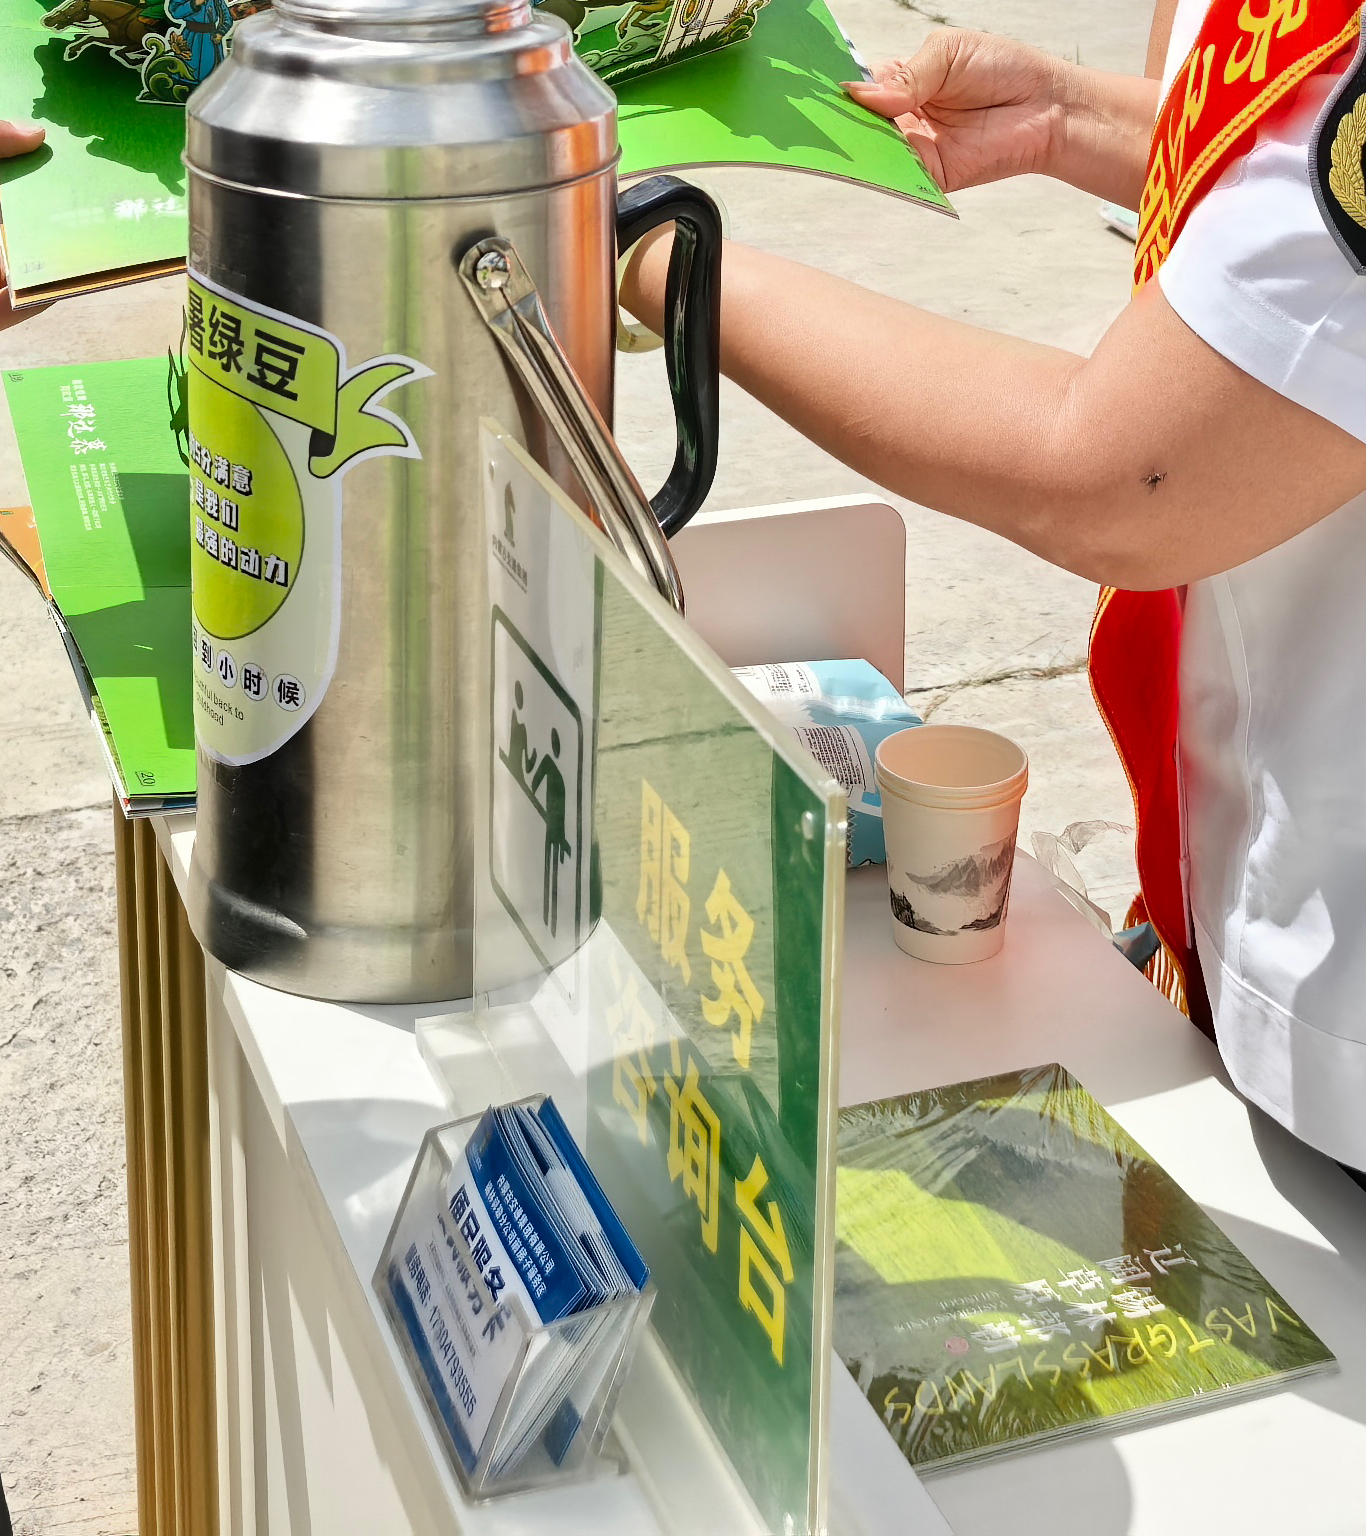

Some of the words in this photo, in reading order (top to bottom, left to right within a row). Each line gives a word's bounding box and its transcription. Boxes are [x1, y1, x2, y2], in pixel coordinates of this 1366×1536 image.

[189, 288, 306, 402] 暑绿豆
[59, 403, 108, 455] 那达慕
[192, 477, 239, 533] 是我们
[195, 515, 289, 588] 最强的动力
[234, 707, 245, 721] to
[140, 771, 156, 784] 20
[635, 778, 765, 1069] 服务
[607, 949, 796, 1368] 咨询台
[496, 1174, 555, 1277] 内蒙古交通集团有限公司
